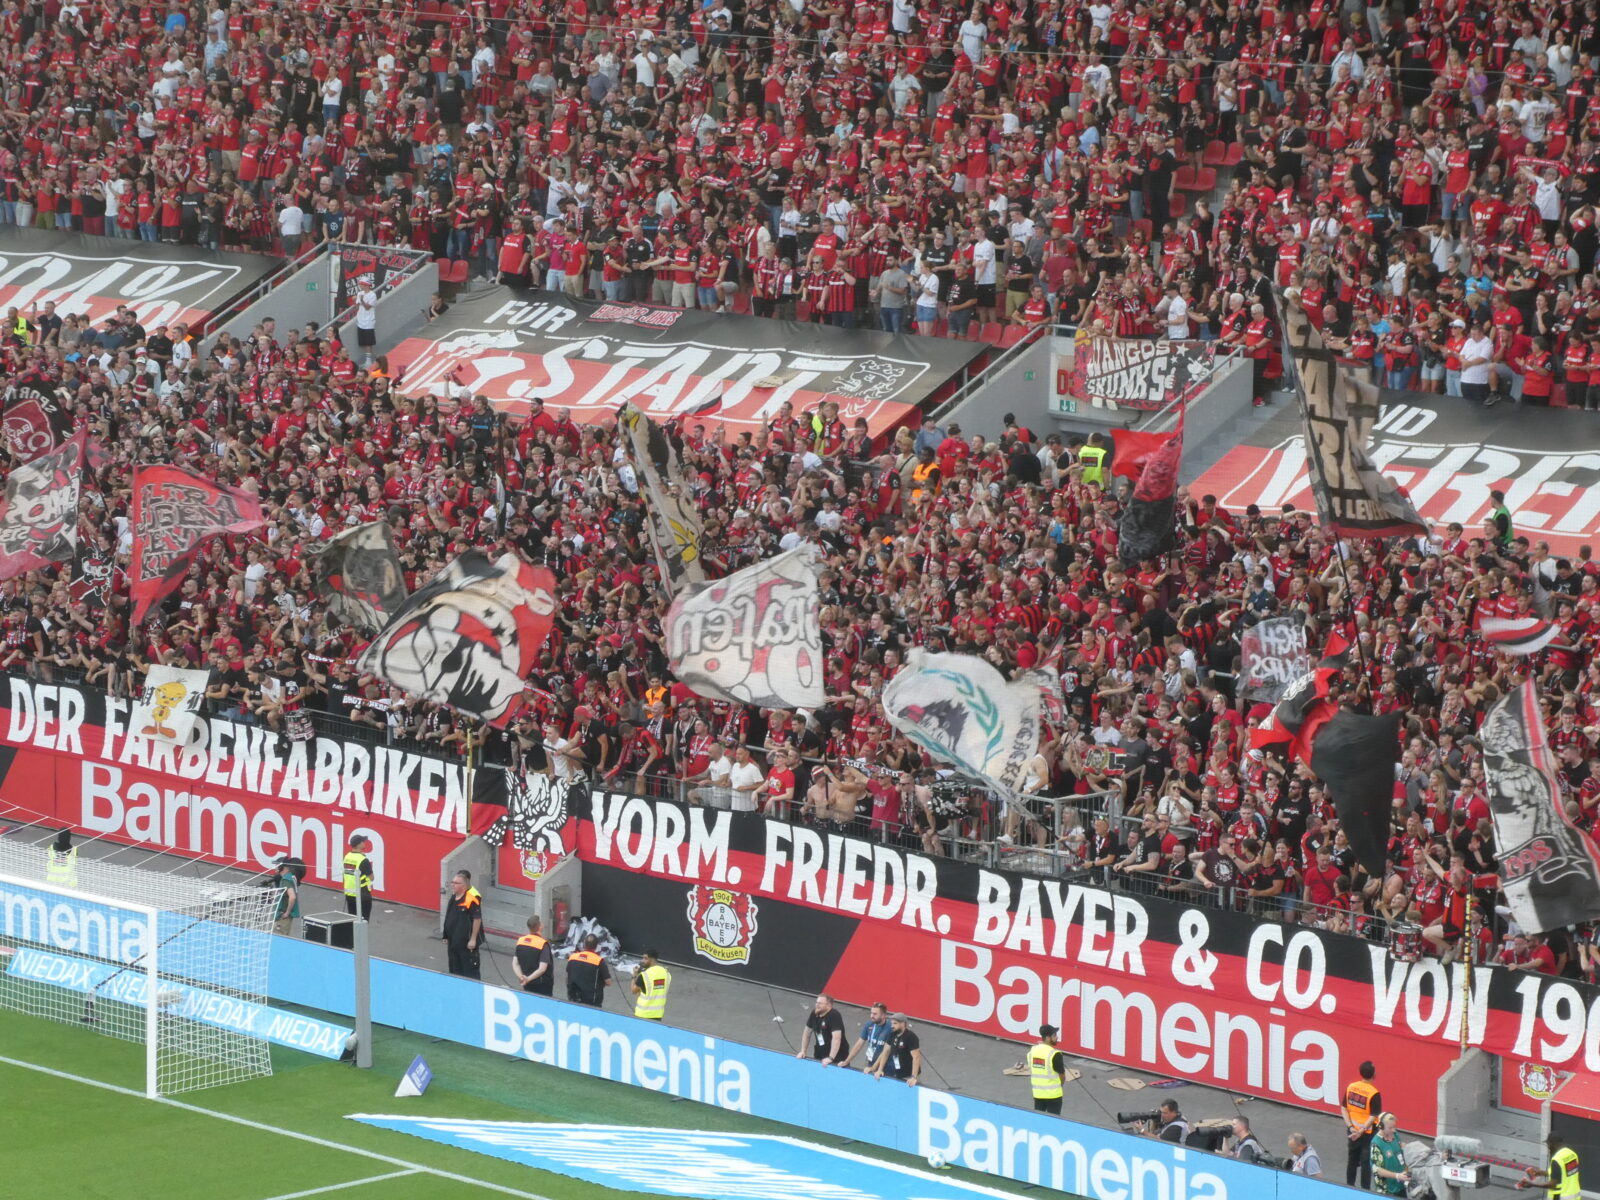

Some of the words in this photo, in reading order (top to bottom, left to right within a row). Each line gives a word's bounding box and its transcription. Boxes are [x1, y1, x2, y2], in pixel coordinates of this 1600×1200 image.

[483, 300, 577, 333] FÜR
[507, 337, 852, 423] STADT
[1086, 356, 1167, 401] SKUNKS
[7, 677, 86, 755] DER
[81, 759, 386, 892] Barmenia
[591, 791, 742, 885] VORM.
[760, 818, 952, 935] FRIEDR.
[972, 867, 1150, 976] BAYER
[1170, 908, 1219, 990] &
[1245, 922, 1337, 1015] CO.
[1368, 943, 1493, 1046] VON
[708, 919, 736, 931] BAYER
[714, 892, 730, 901] 1904
[700, 940, 743, 959] Leverkusen
[12, 949, 96, 990] NIEDAX
[184, 988, 262, 1038] NIEDAX
[267, 1013, 351, 1057] NIEDAX
[939, 938, 1340, 1106] Barmenia
[483, 984, 752, 1116] Barmenia
